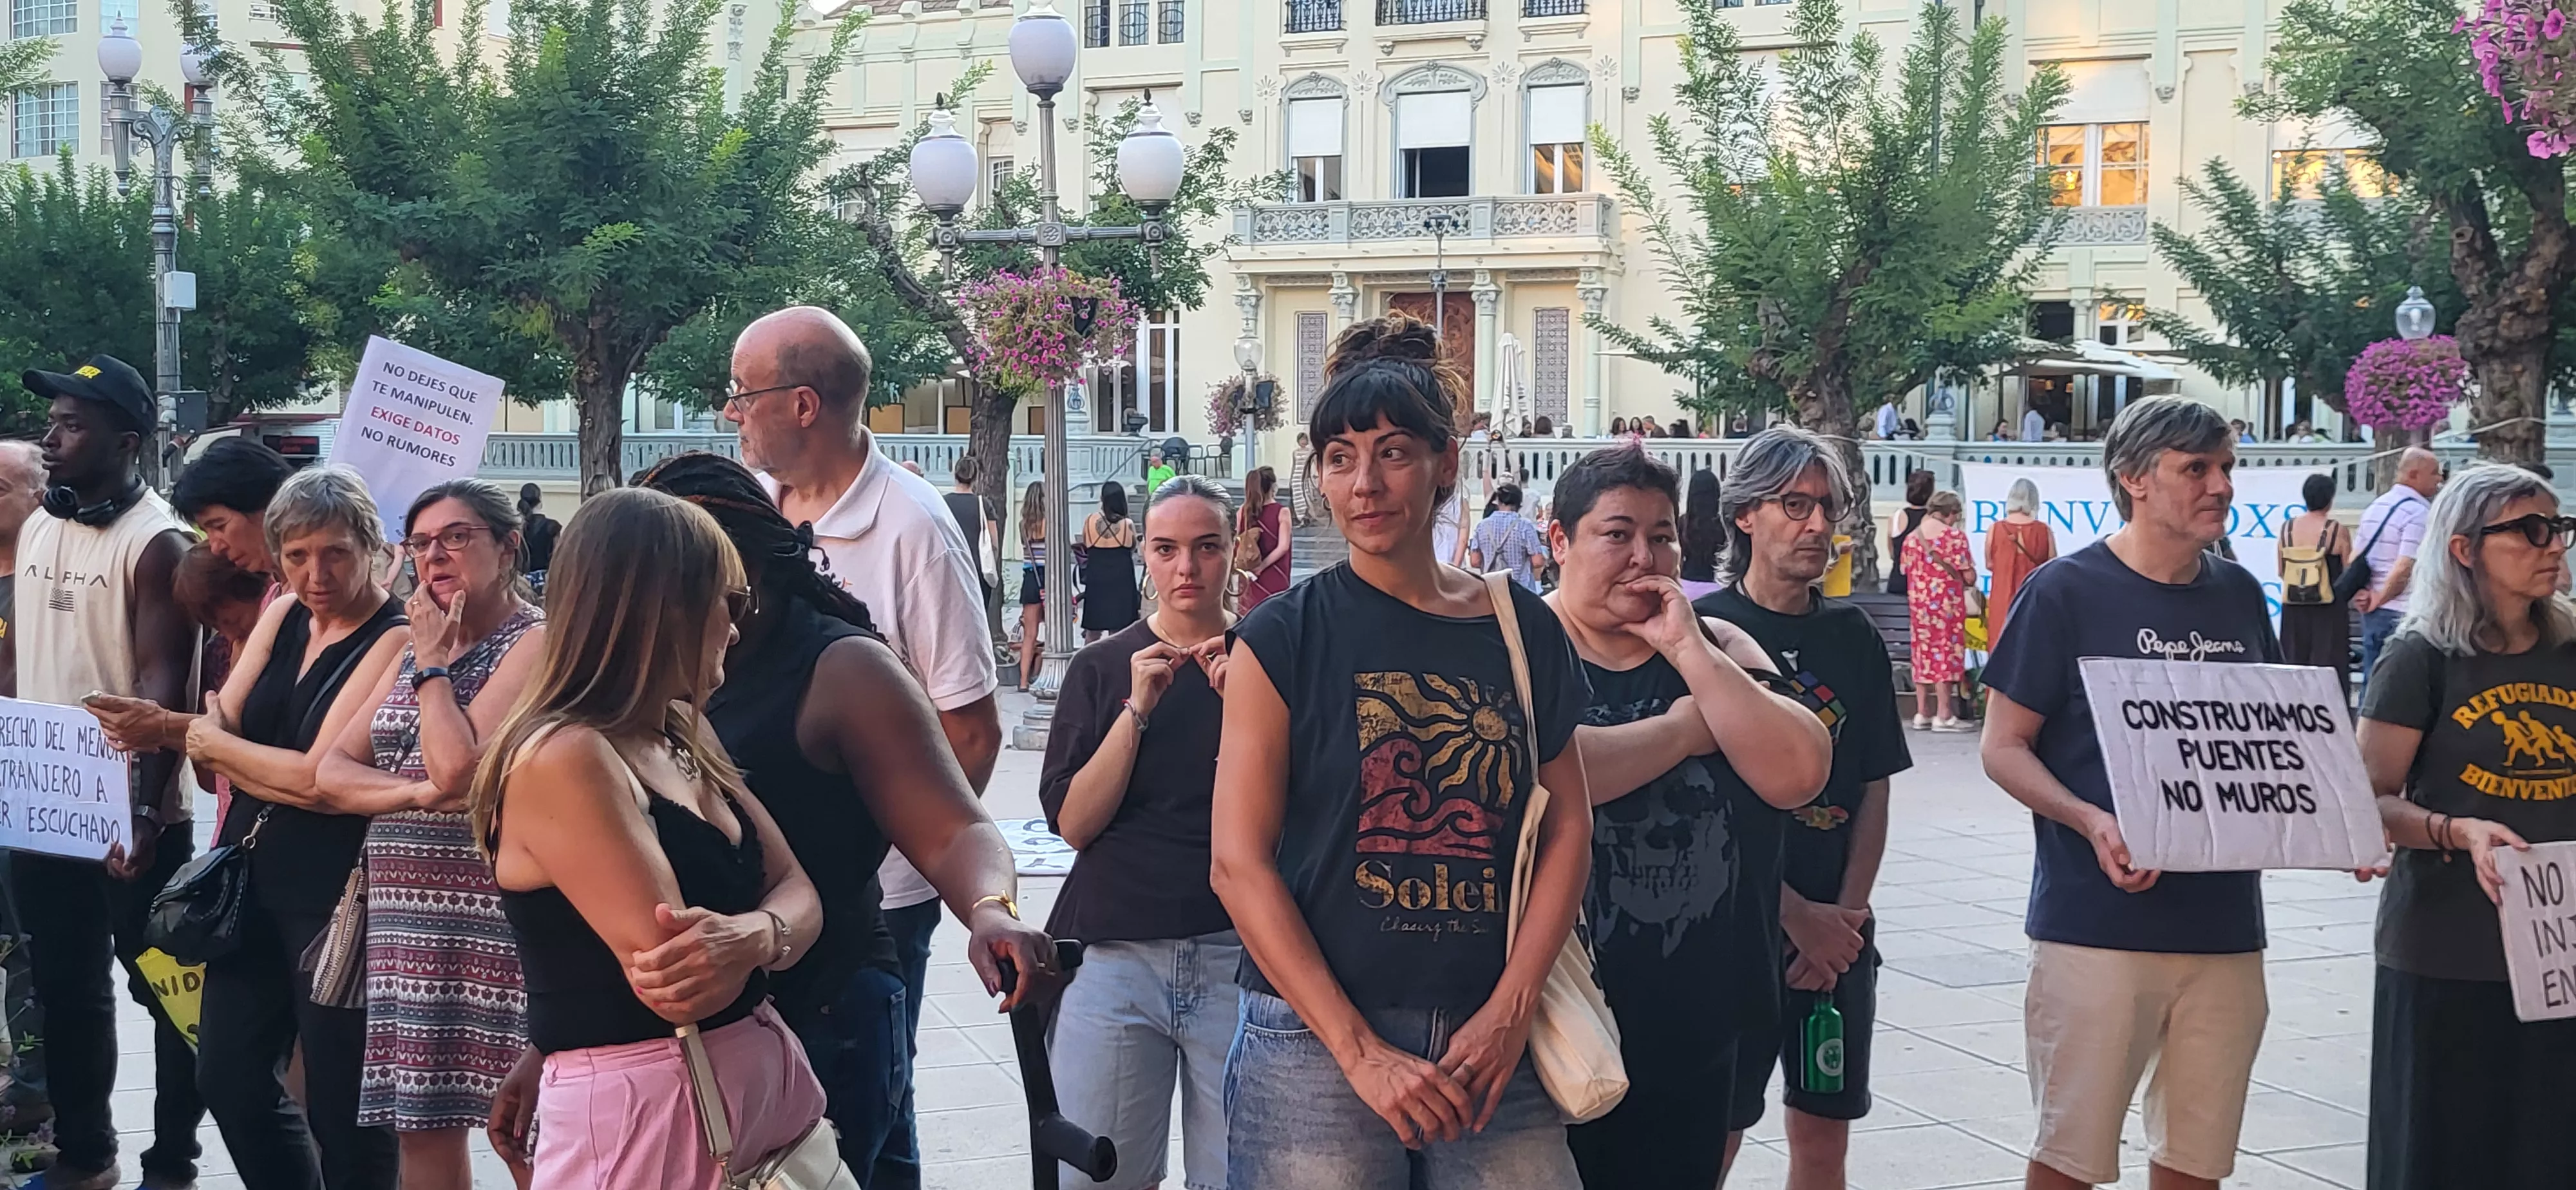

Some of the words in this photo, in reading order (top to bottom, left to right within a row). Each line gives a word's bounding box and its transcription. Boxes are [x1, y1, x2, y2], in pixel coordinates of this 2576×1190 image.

[383, 361, 405, 377] NO
[407, 370, 447, 393] DEJES
[448, 384, 478, 404] QUE
[372, 379, 389, 395] TE
[390, 387, 474, 426] MANIPULEN.
[370, 405, 412, 430] EXIGE
[413, 420, 461, 446] DATOS
[361, 426, 384, 442] NO
[386, 434, 457, 468] RUMORES
[2136, 628, 2190, 662] Pepe
[2189, 630, 2246, 662] Jeans
[45, 720, 66, 751] DEL
[2121, 699, 2336, 735] CONSTRUYAMOS
[2177, 738, 2305, 771] PUENTES
[96, 773, 109, 804] A
[2161, 779, 2204, 812] NO
[2215, 780, 2317, 815] MUROS
[28, 806, 121, 845] ESCUCHADO
[2521, 861, 2564, 909] NO
